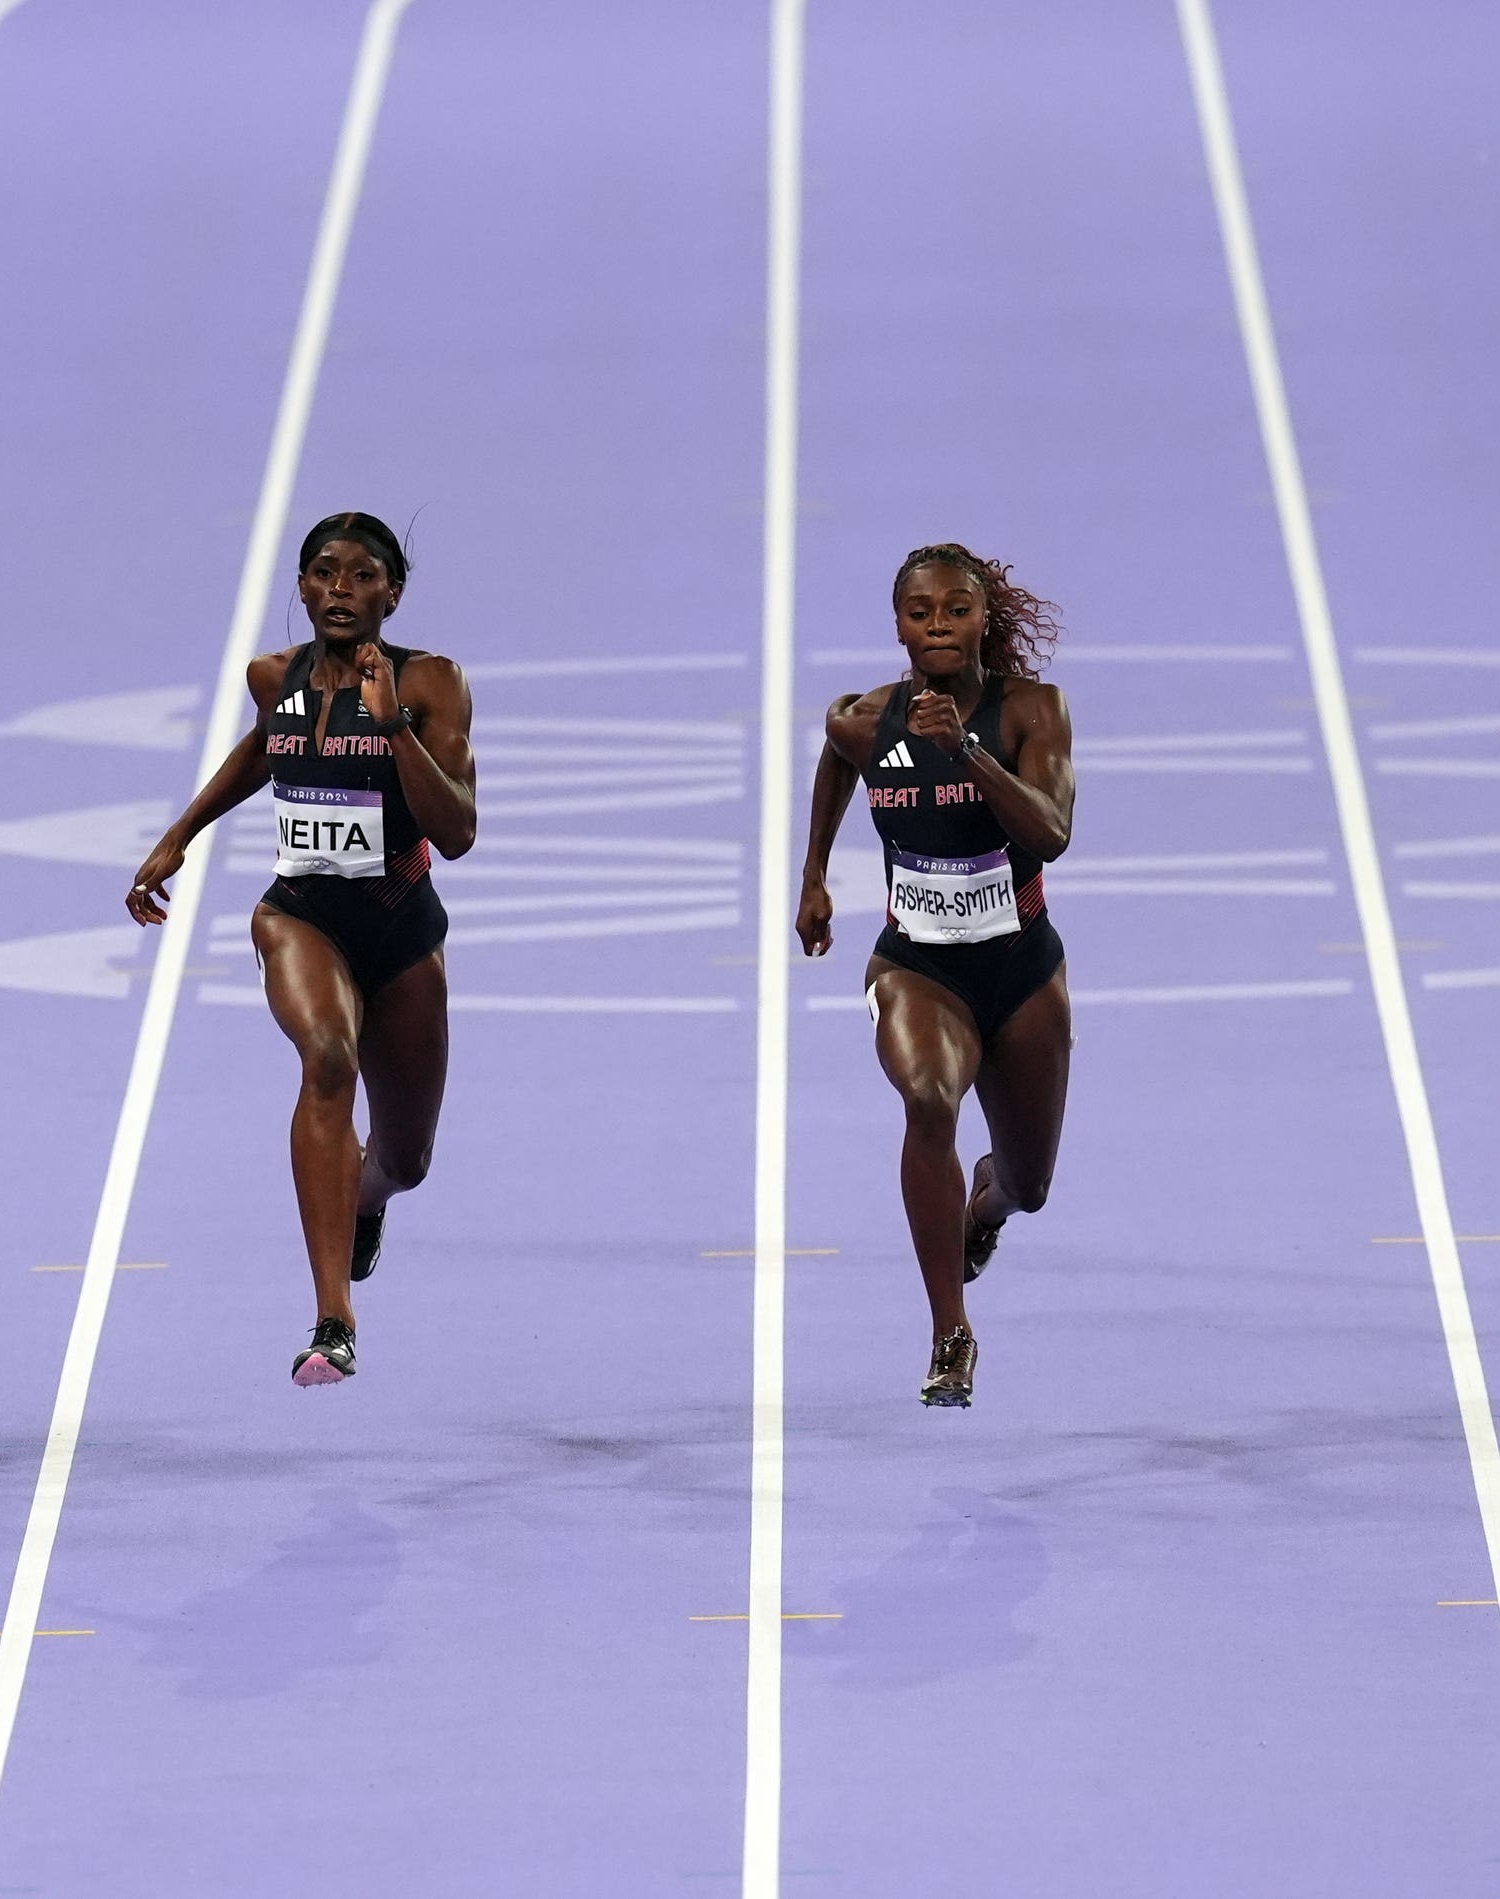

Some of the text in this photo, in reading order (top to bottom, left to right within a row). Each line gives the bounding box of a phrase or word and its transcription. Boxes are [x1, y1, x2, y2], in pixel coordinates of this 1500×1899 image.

[266, 734, 308, 755] REAT
[288, 790, 348, 801] PARIS 2024
[935, 782, 983, 806] BRIT
[279, 815, 372, 851] NEITA
[916, 860, 977, 872] PARIS 2024
[894, 880, 1012, 917] ASHER-SMITH
